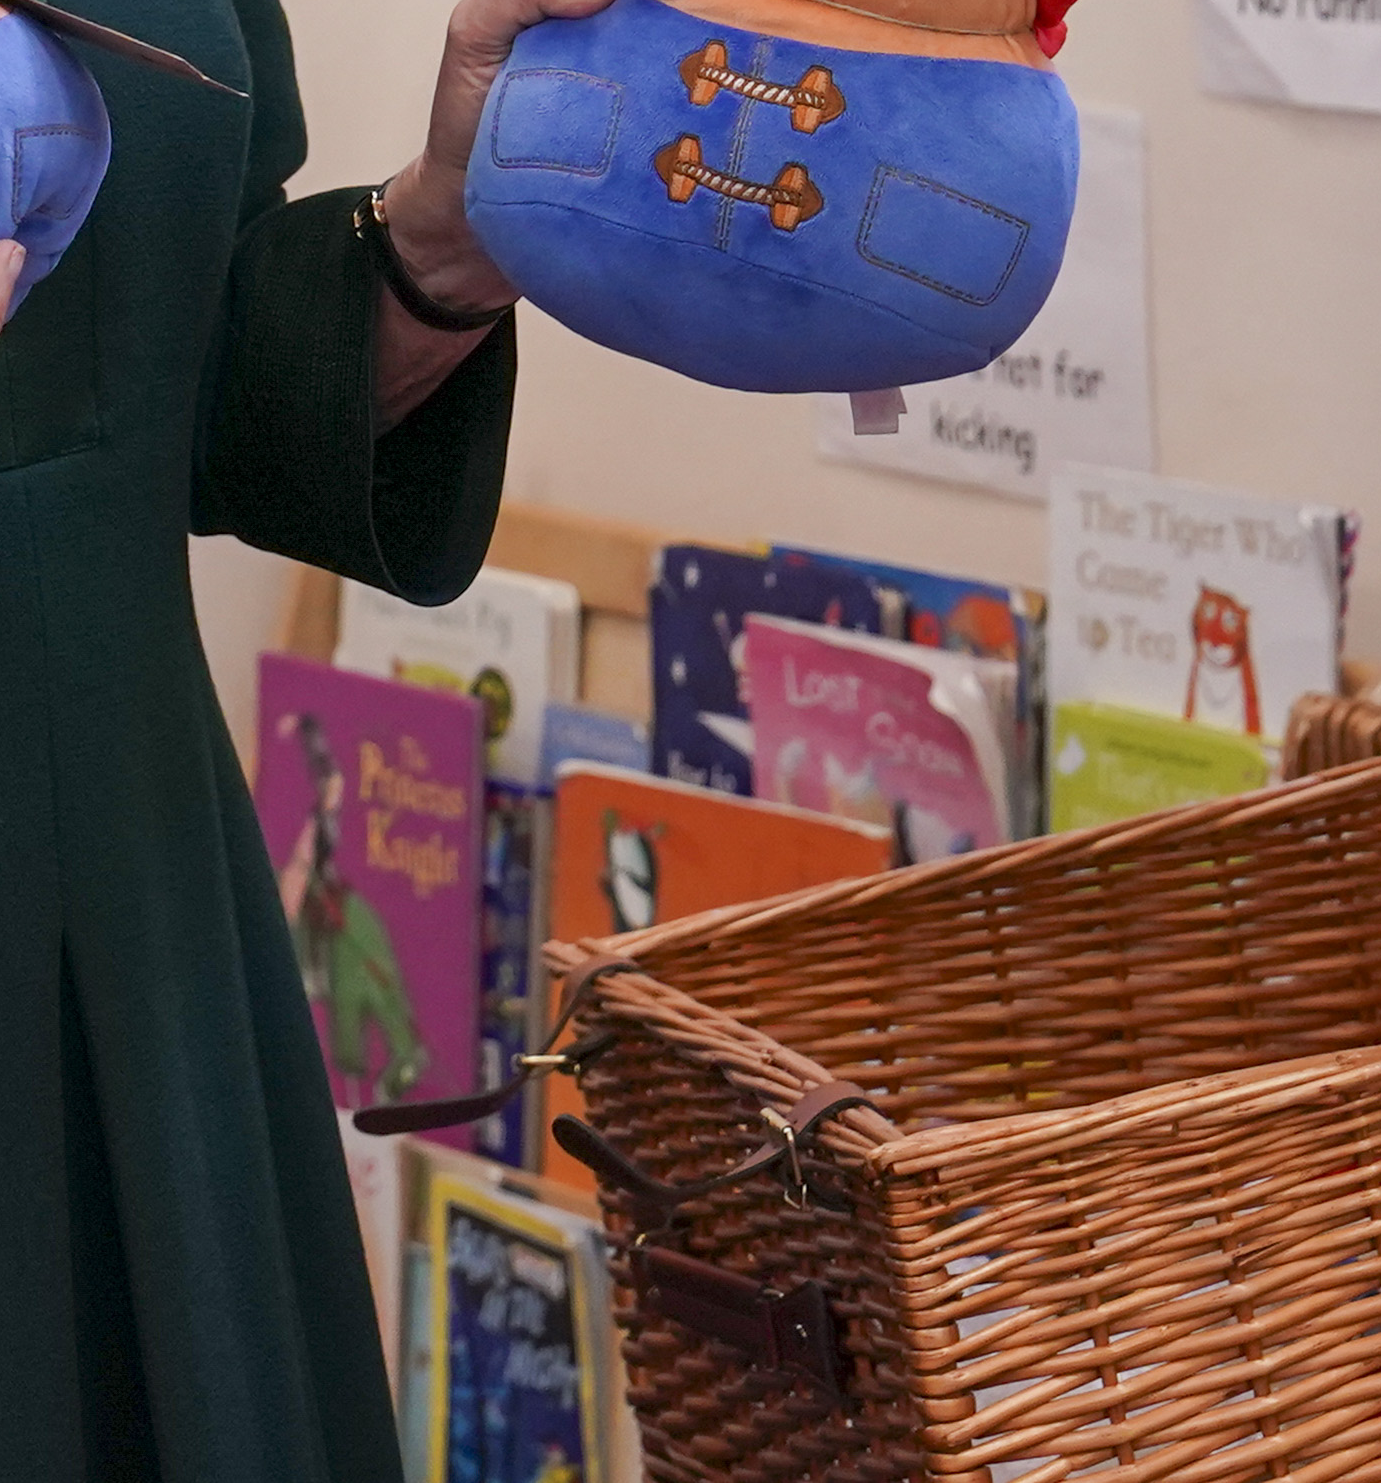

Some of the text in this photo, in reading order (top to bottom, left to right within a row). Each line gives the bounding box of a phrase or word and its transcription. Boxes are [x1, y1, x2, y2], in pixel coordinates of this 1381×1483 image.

[1054, 347, 1107, 400] for
[930, 399, 1039, 477] kicking
[1076, 490, 1137, 538] The
[1142, 500, 1224, 560] Tiger
[1076, 548, 1168, 603] Came
[1116, 614, 1176, 662] Tea
[359, 740, 467, 821] Princess
[367, 809, 460, 900] Knight
